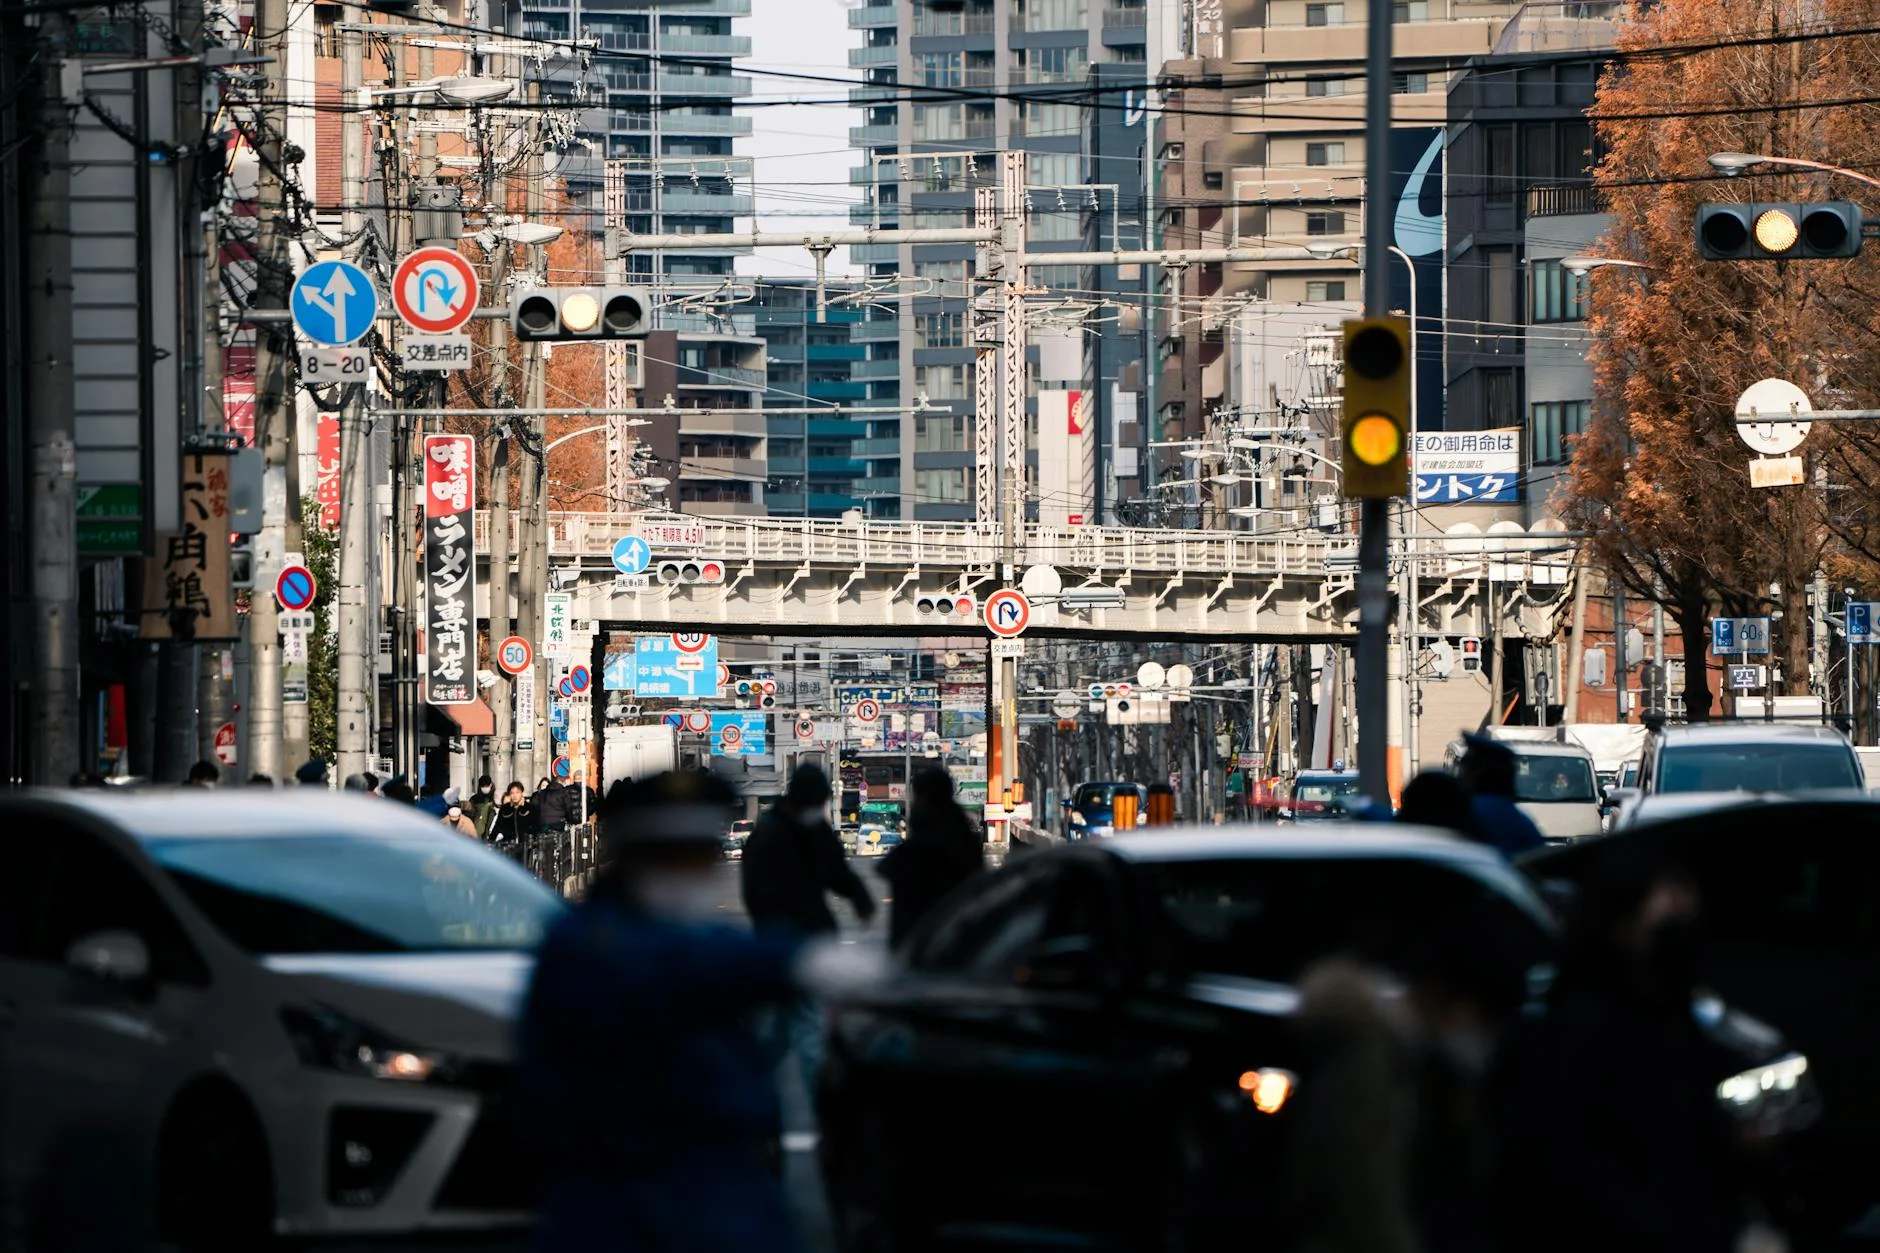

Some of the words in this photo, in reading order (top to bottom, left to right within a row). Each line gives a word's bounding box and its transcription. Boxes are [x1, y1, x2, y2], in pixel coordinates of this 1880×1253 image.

[407, 344, 468, 361] 交差点内
[280, 617, 312, 628] 自動車
[1854, 607, 1865, 625] P
[1719, 622, 1730, 638] P
[505, 647, 525, 663] 50
[994, 644, 1022, 653] 交差点内
[1733, 667, 1756, 687] 空
